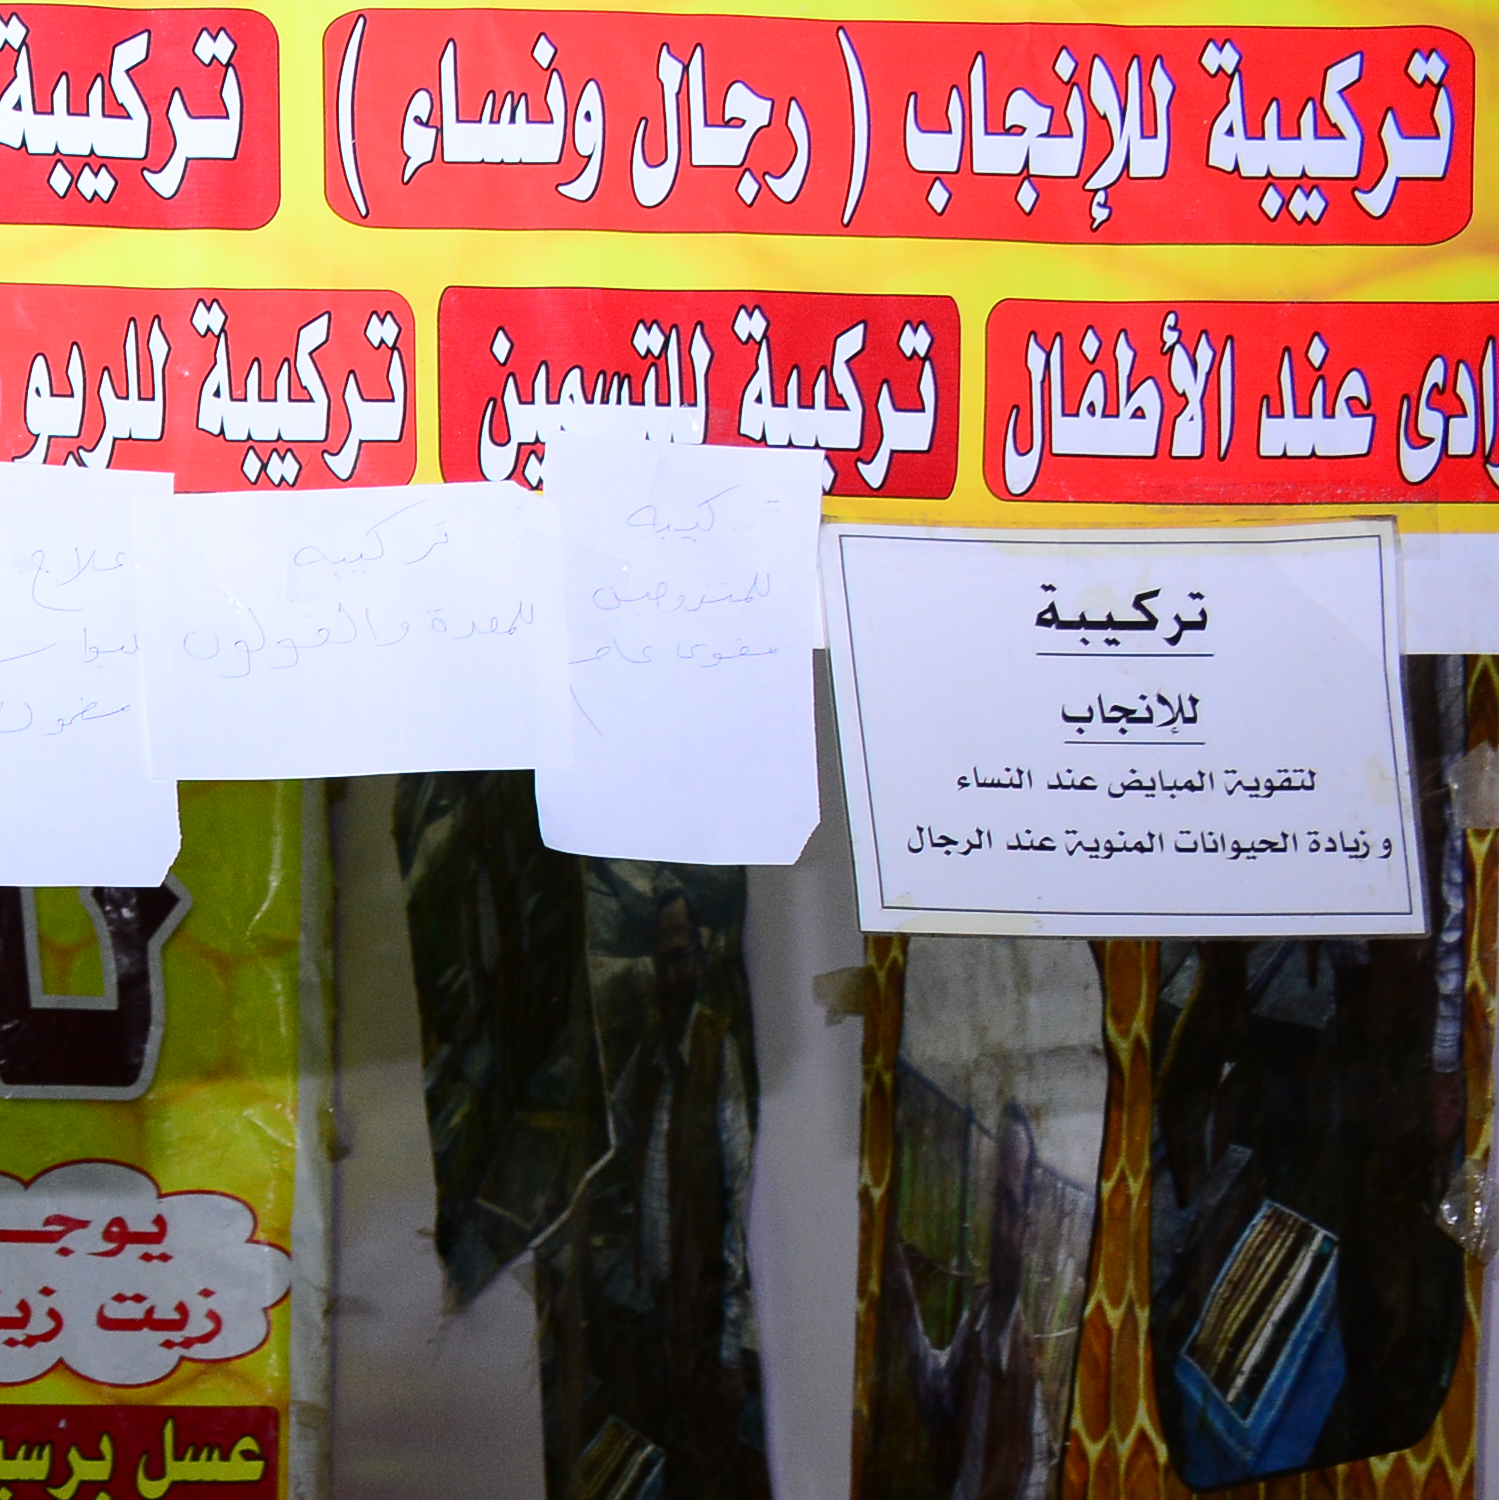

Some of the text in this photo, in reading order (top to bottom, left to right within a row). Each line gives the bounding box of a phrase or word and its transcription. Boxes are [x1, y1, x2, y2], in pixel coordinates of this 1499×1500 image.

[401, 31, 1454, 231] تركيبة للإنجاب رجال ونساء
[13, 314, 171, 468] للربو
[189, 299, 406, 486] تركيبة
[478, 304, 937, 494] تركيبة للتسمين
[1003, 310, 1376, 496] عند الأطفال
[1035, 584, 1209, 648] تركيبة
[1061, 692, 1200, 735] للإنجاب
[956, 765, 1316, 800] لتقوية المبايض عند النساء
[906, 828, 1372, 861] زيادة الحيوانات المنوية عند الرجال
[94, 1287, 223, 1349] زيت
[135, 1417, 265, 1500] عسل
